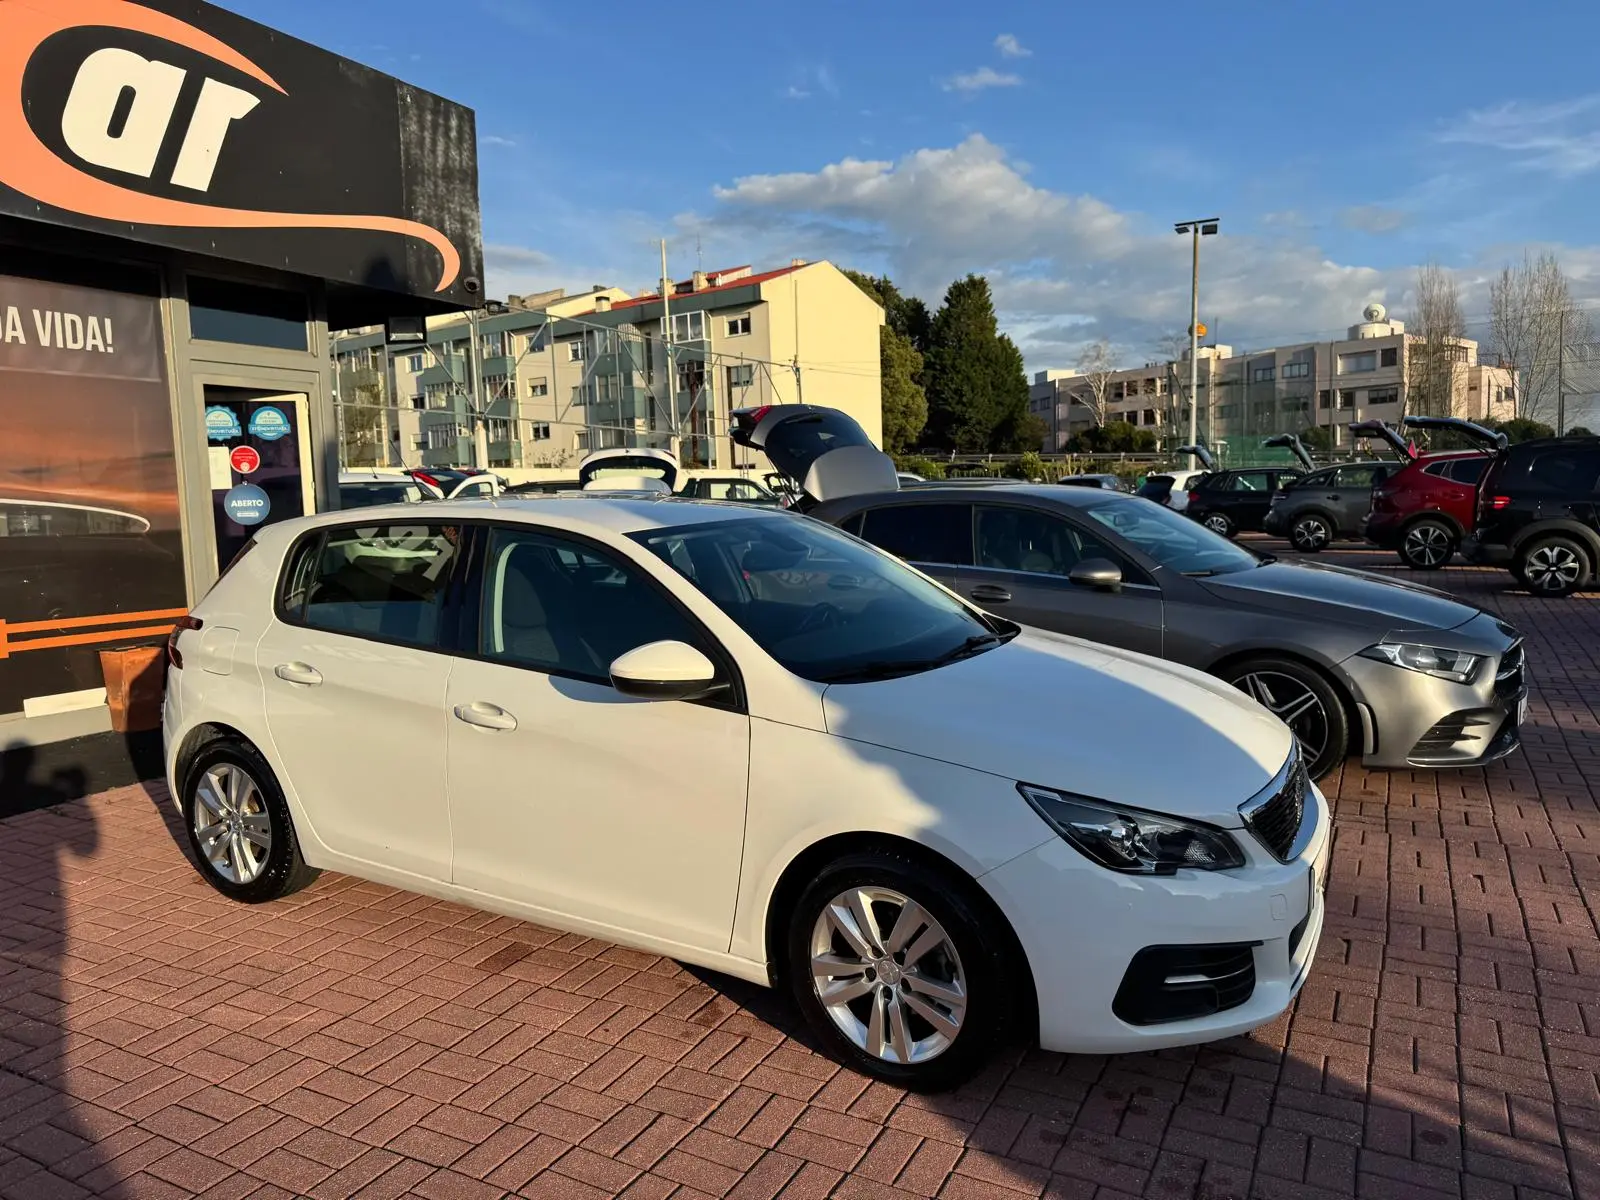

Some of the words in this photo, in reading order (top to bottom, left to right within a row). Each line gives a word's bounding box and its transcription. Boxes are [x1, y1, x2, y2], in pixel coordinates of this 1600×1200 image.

[0, 306, 26, 345] A
[32, 309, 114, 353] VIDA!
[231, 499, 264, 507] ABERTO
